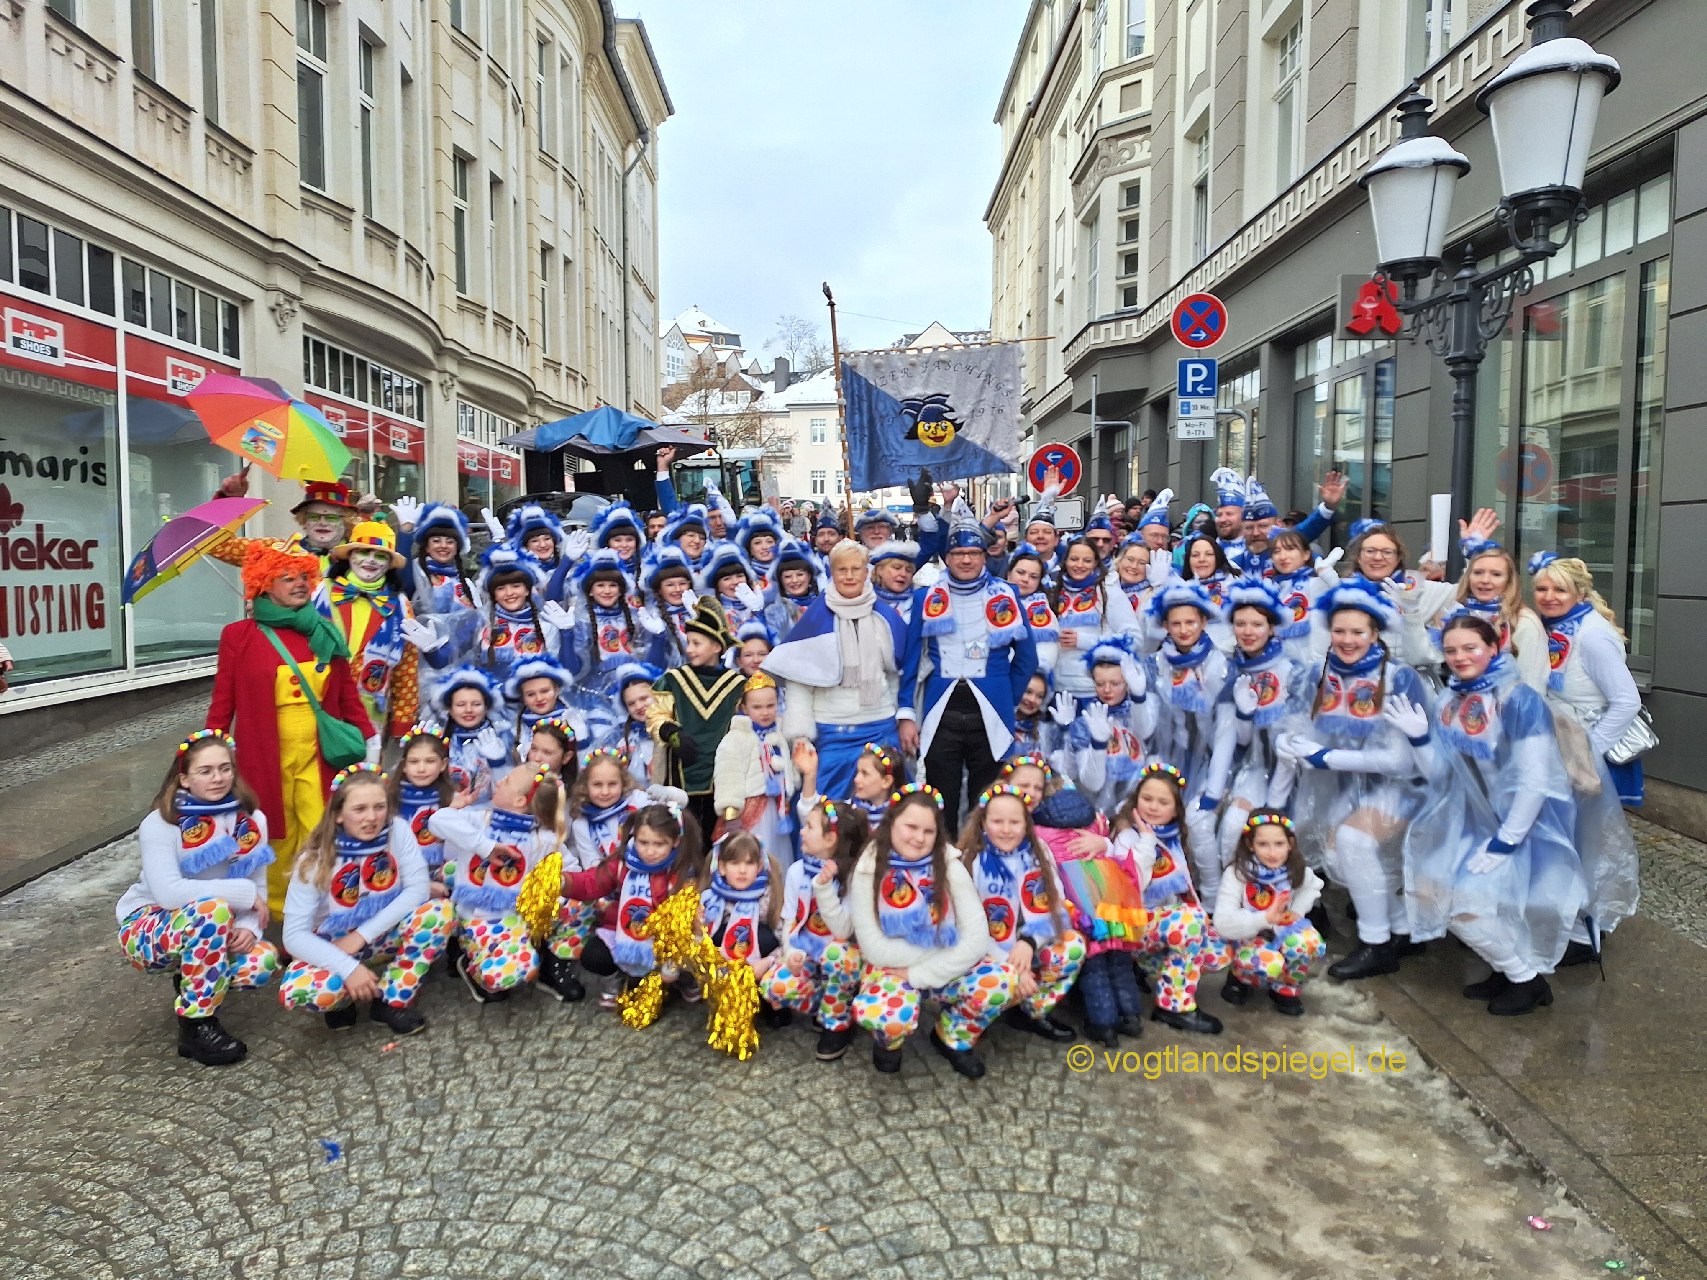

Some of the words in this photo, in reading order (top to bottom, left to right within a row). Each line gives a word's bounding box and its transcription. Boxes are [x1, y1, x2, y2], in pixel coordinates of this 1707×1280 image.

[20, 339, 52, 356] SHOES
[176, 381, 197, 392] SHOE
[1186, 363, 1208, 393] P
[0, 582, 106, 639] USTANG
